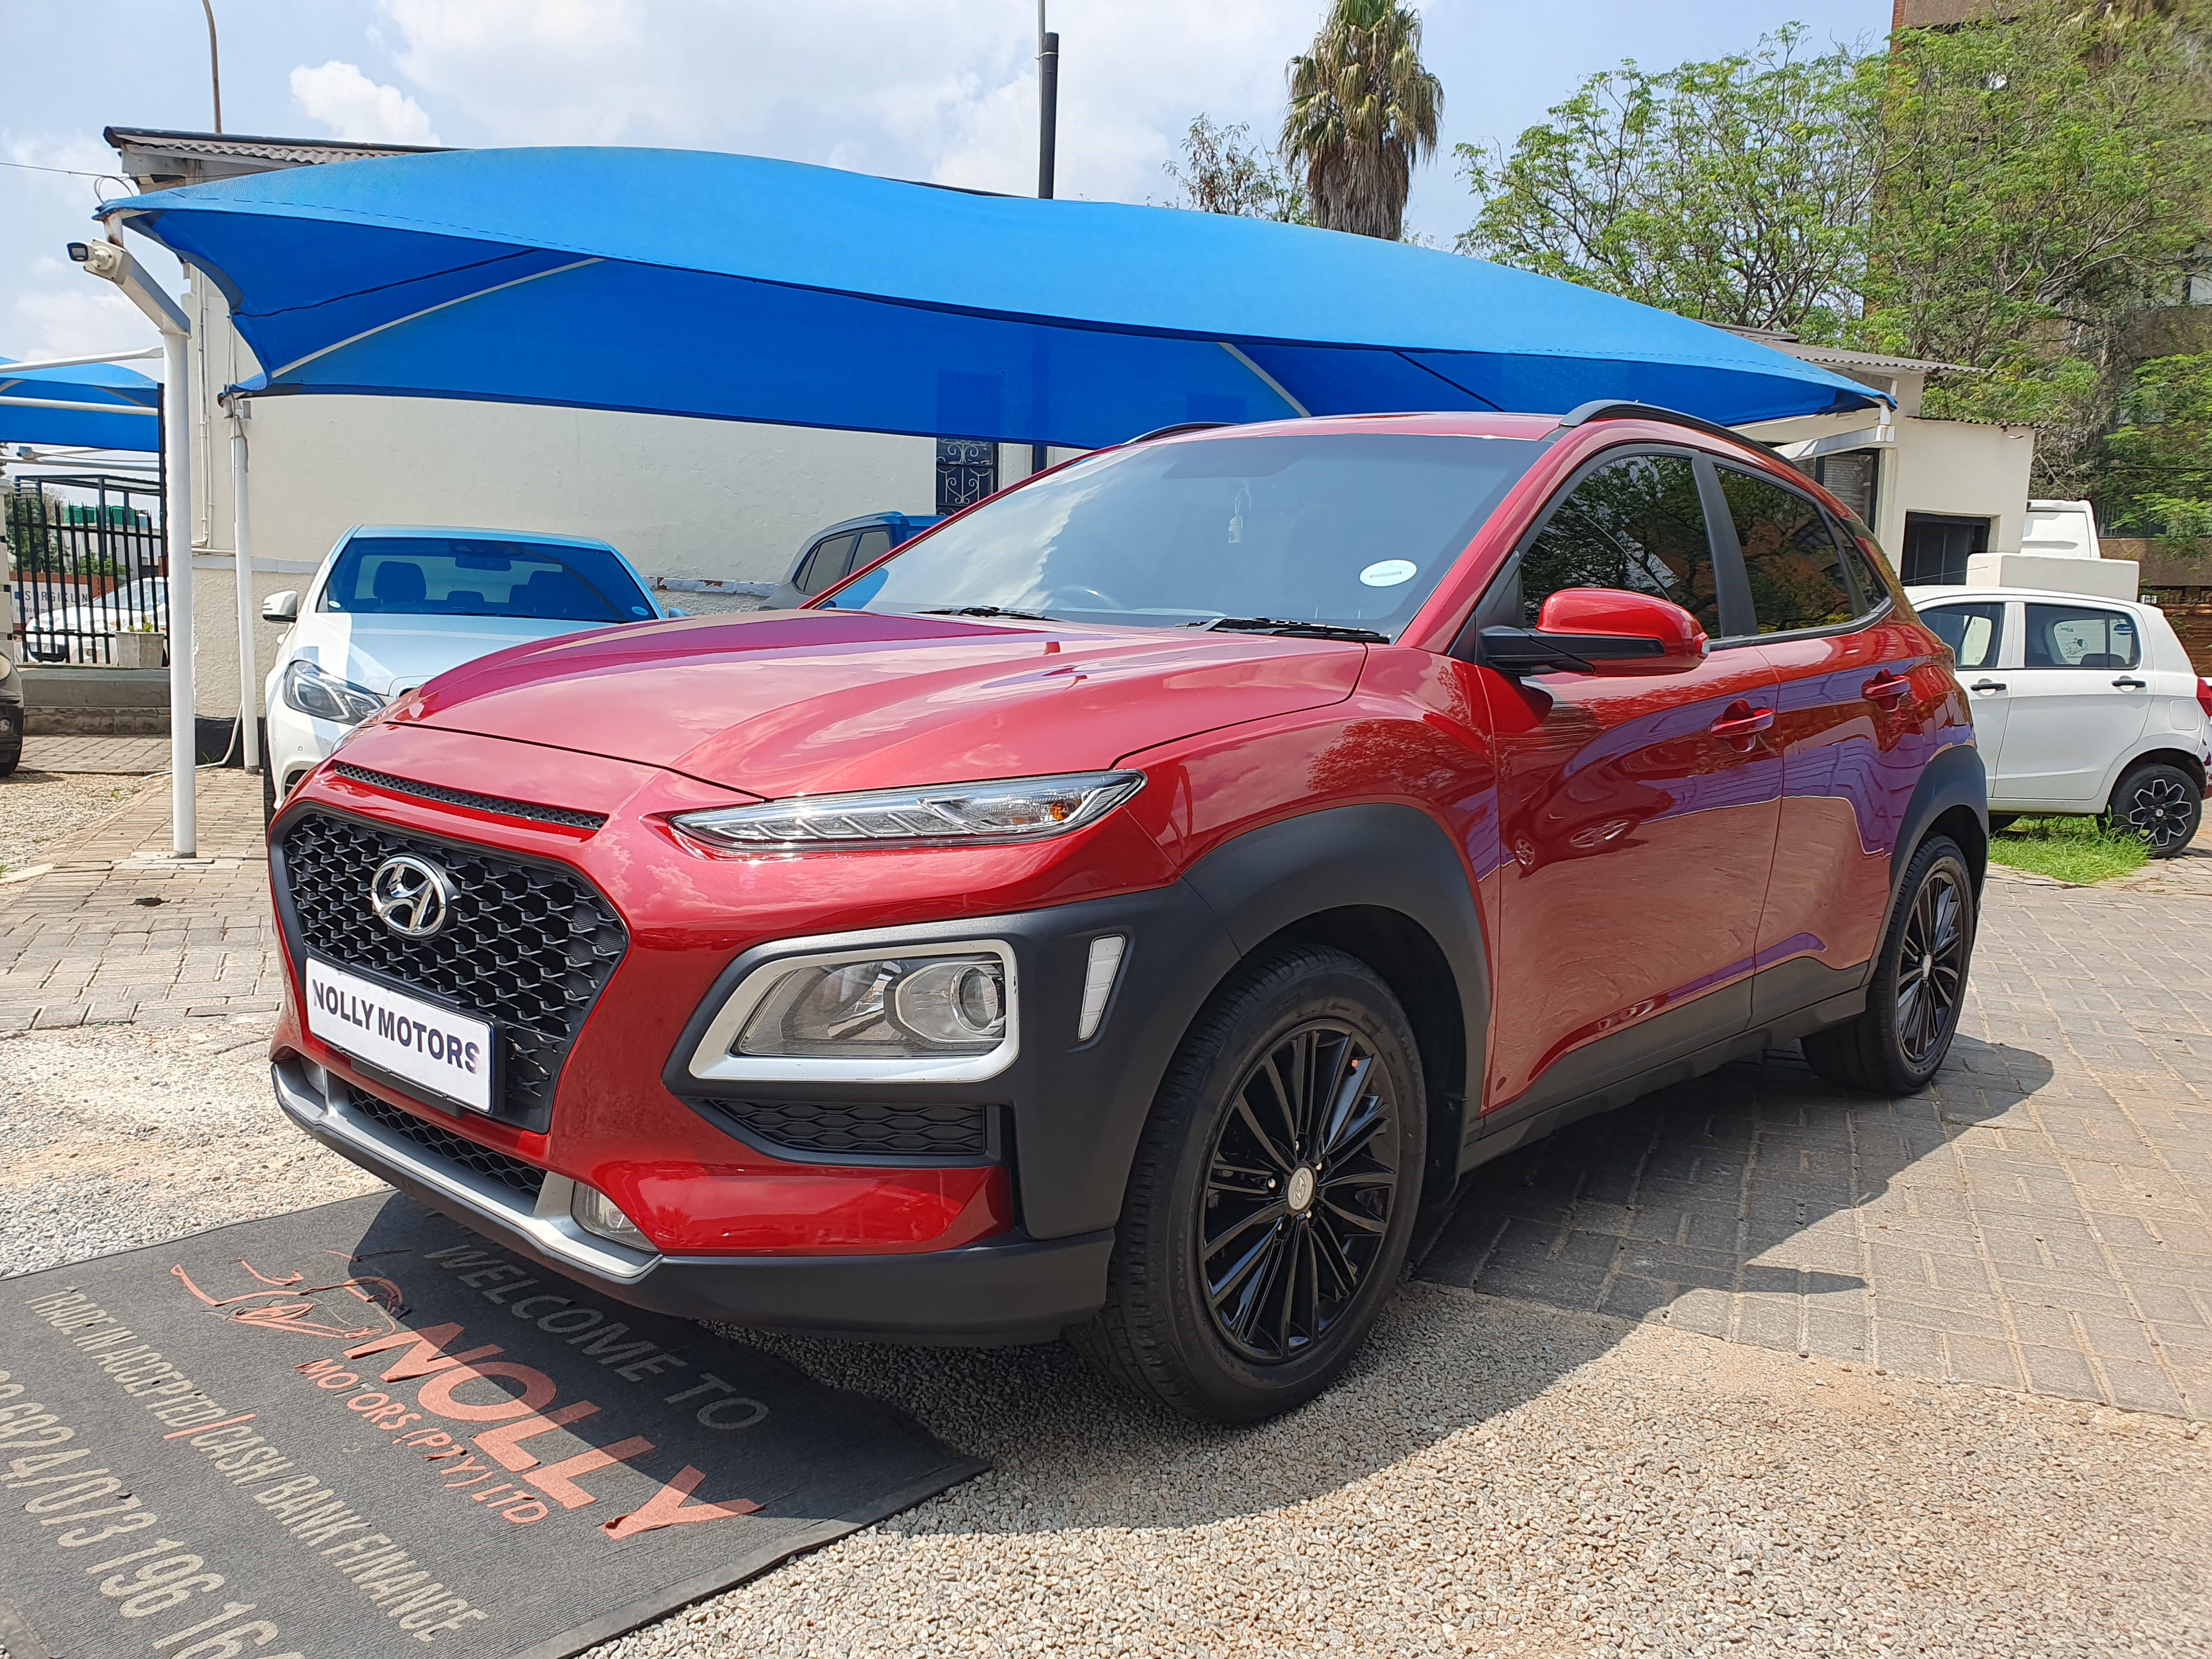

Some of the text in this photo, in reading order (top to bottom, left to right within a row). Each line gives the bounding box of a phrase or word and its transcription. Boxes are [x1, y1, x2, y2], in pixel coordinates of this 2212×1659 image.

[312, 979, 480, 1074] NOLLY MOTORS
[423, 1245, 769, 1429] WELCOME TO
[25, 1286, 119, 1335] TRADE
[72, 1326, 138, 1351] IN
[320, 1532, 489, 1643] FINANCE
[343, 1322, 765, 1540] NOLLY
[392, 1428, 493, 1488] (PTY)
[471, 1482, 549, 1524] LTD
[86, 1538, 224, 1619] 196
[151, 1601, 305, 1659] 16
